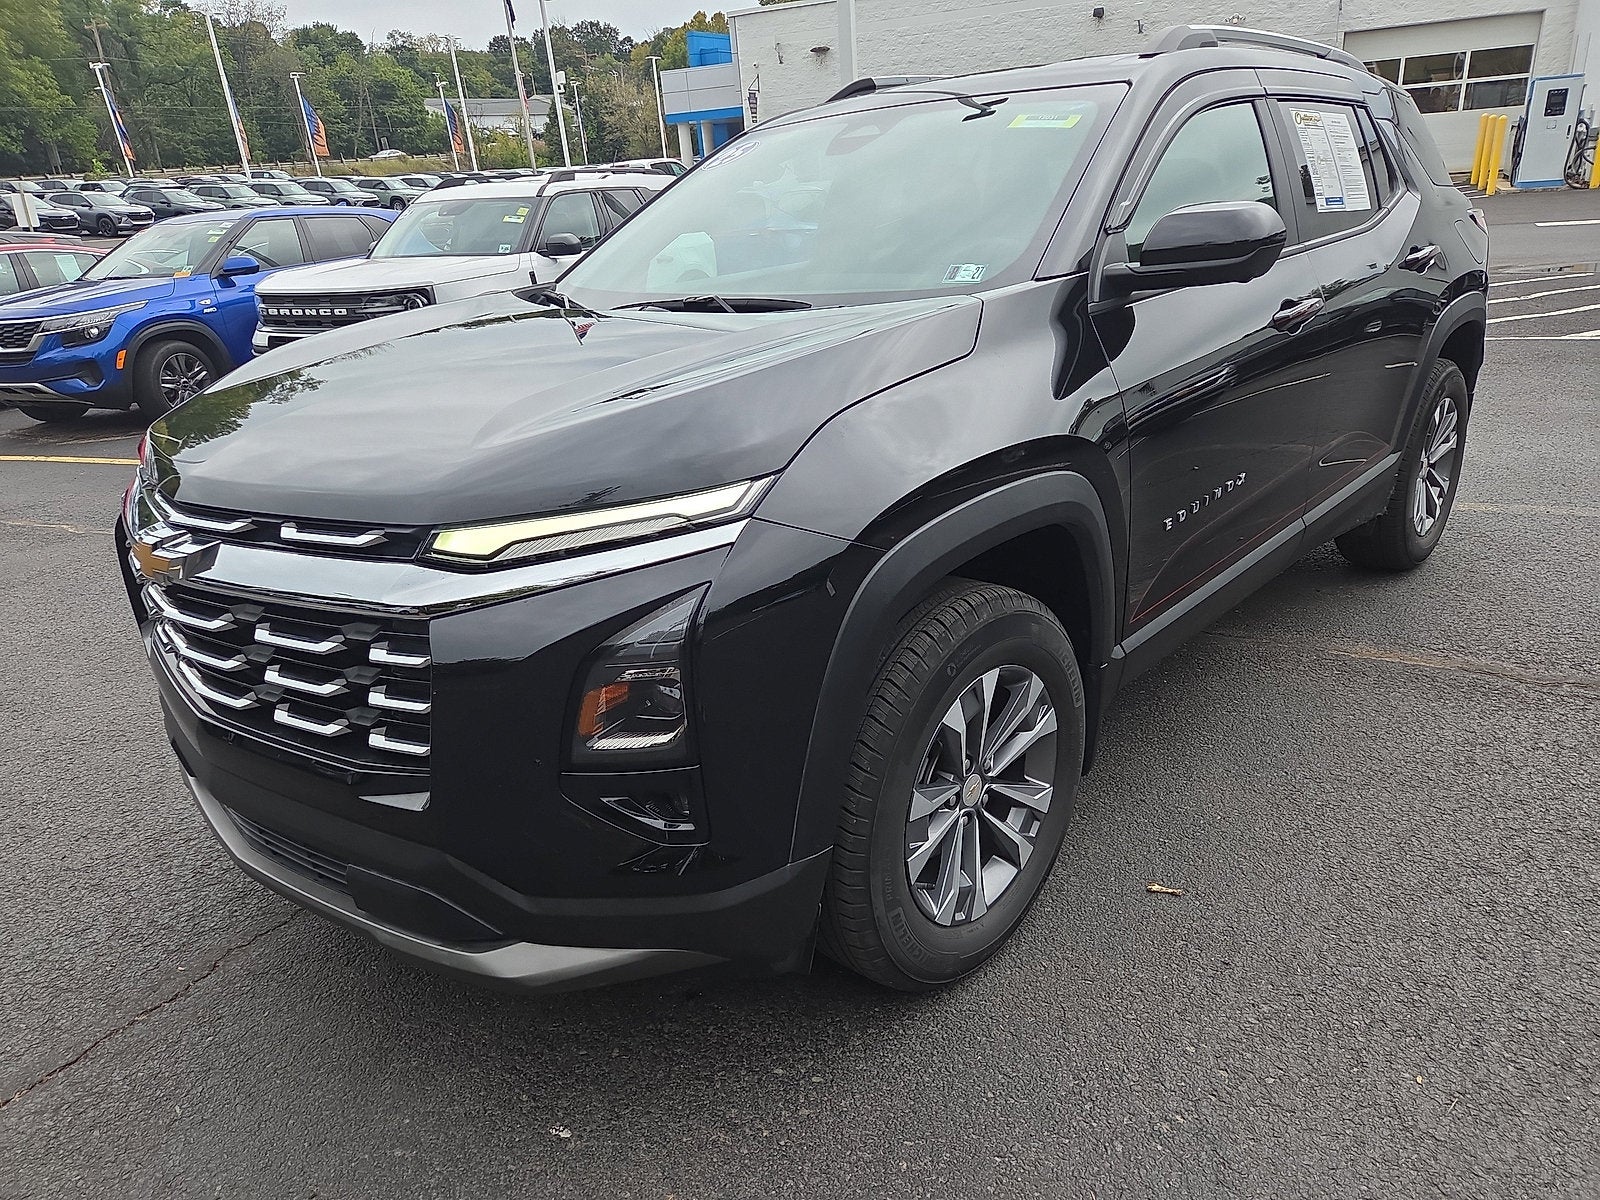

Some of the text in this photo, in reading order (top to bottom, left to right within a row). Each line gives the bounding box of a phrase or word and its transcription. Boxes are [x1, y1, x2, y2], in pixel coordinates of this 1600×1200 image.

[971, 266, 984, 279] 27
[269, 308, 348, 316] BRONCO
[1162, 472, 1246, 532] EQUINOX
